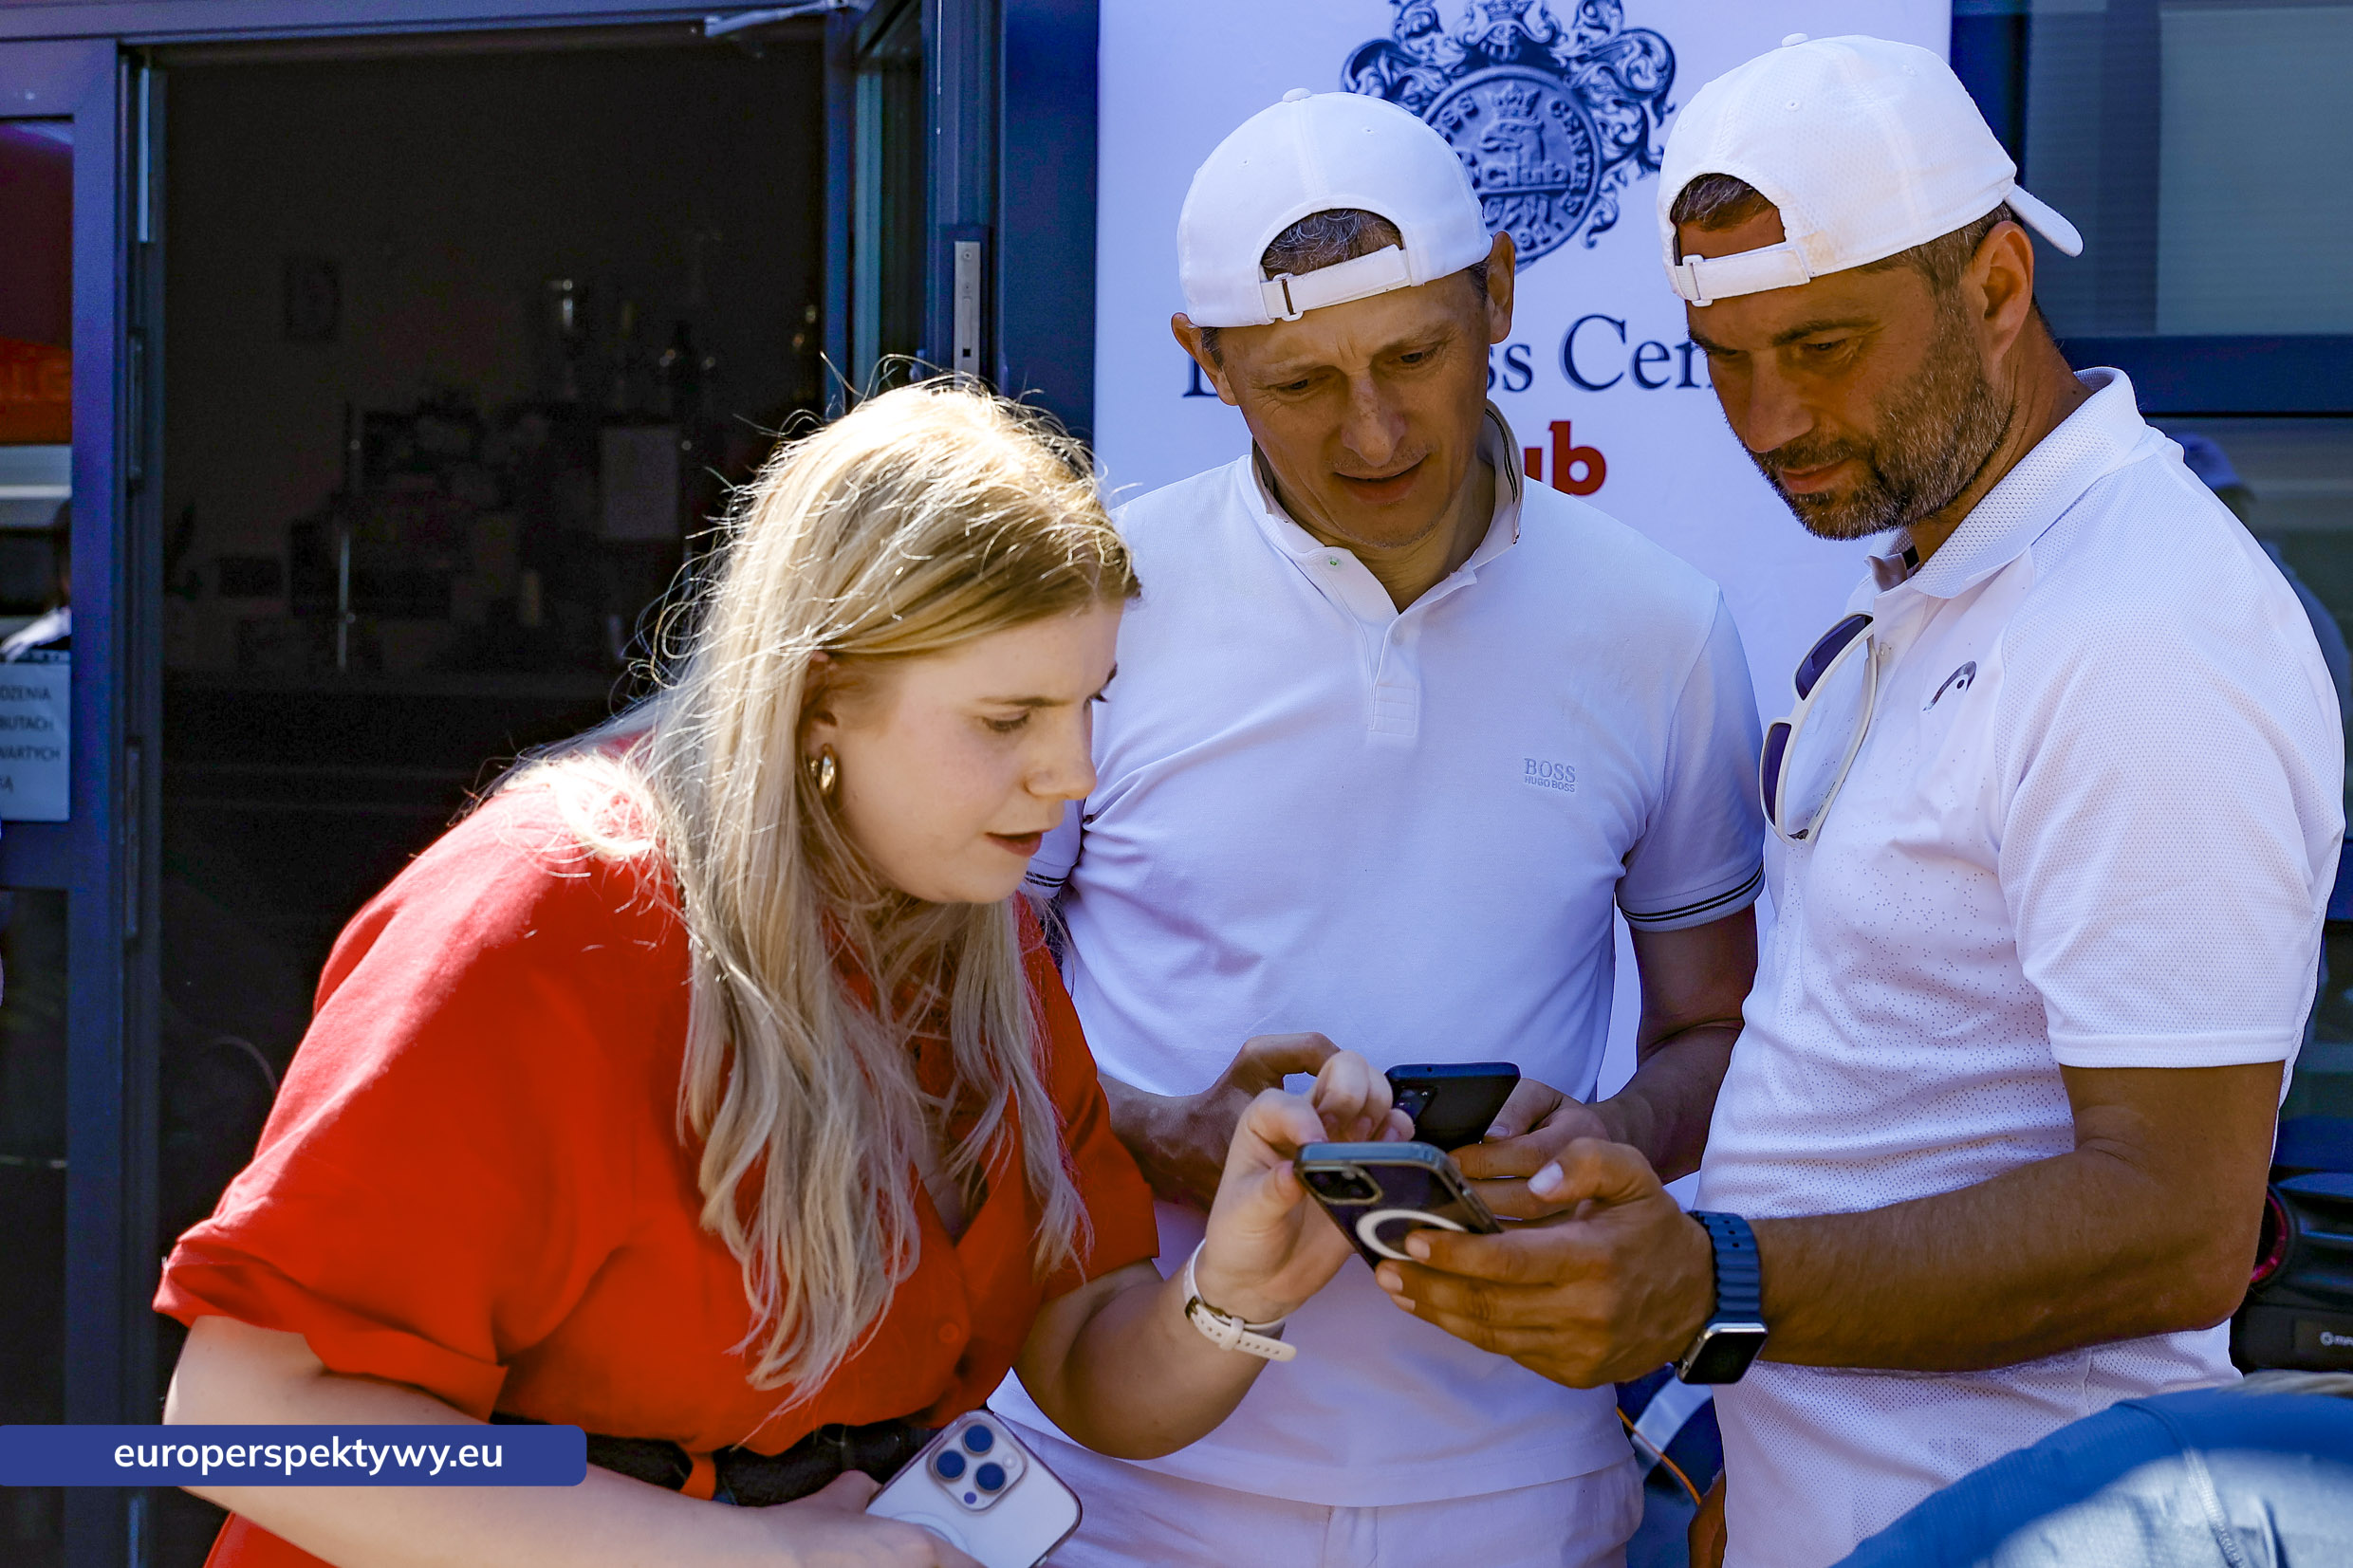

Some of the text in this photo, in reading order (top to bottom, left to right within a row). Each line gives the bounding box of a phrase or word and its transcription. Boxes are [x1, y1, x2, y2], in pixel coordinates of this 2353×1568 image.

[1524, 758, 1576, 784] BOSS
[1525, 776, 1575, 793] HUGO BOSS
